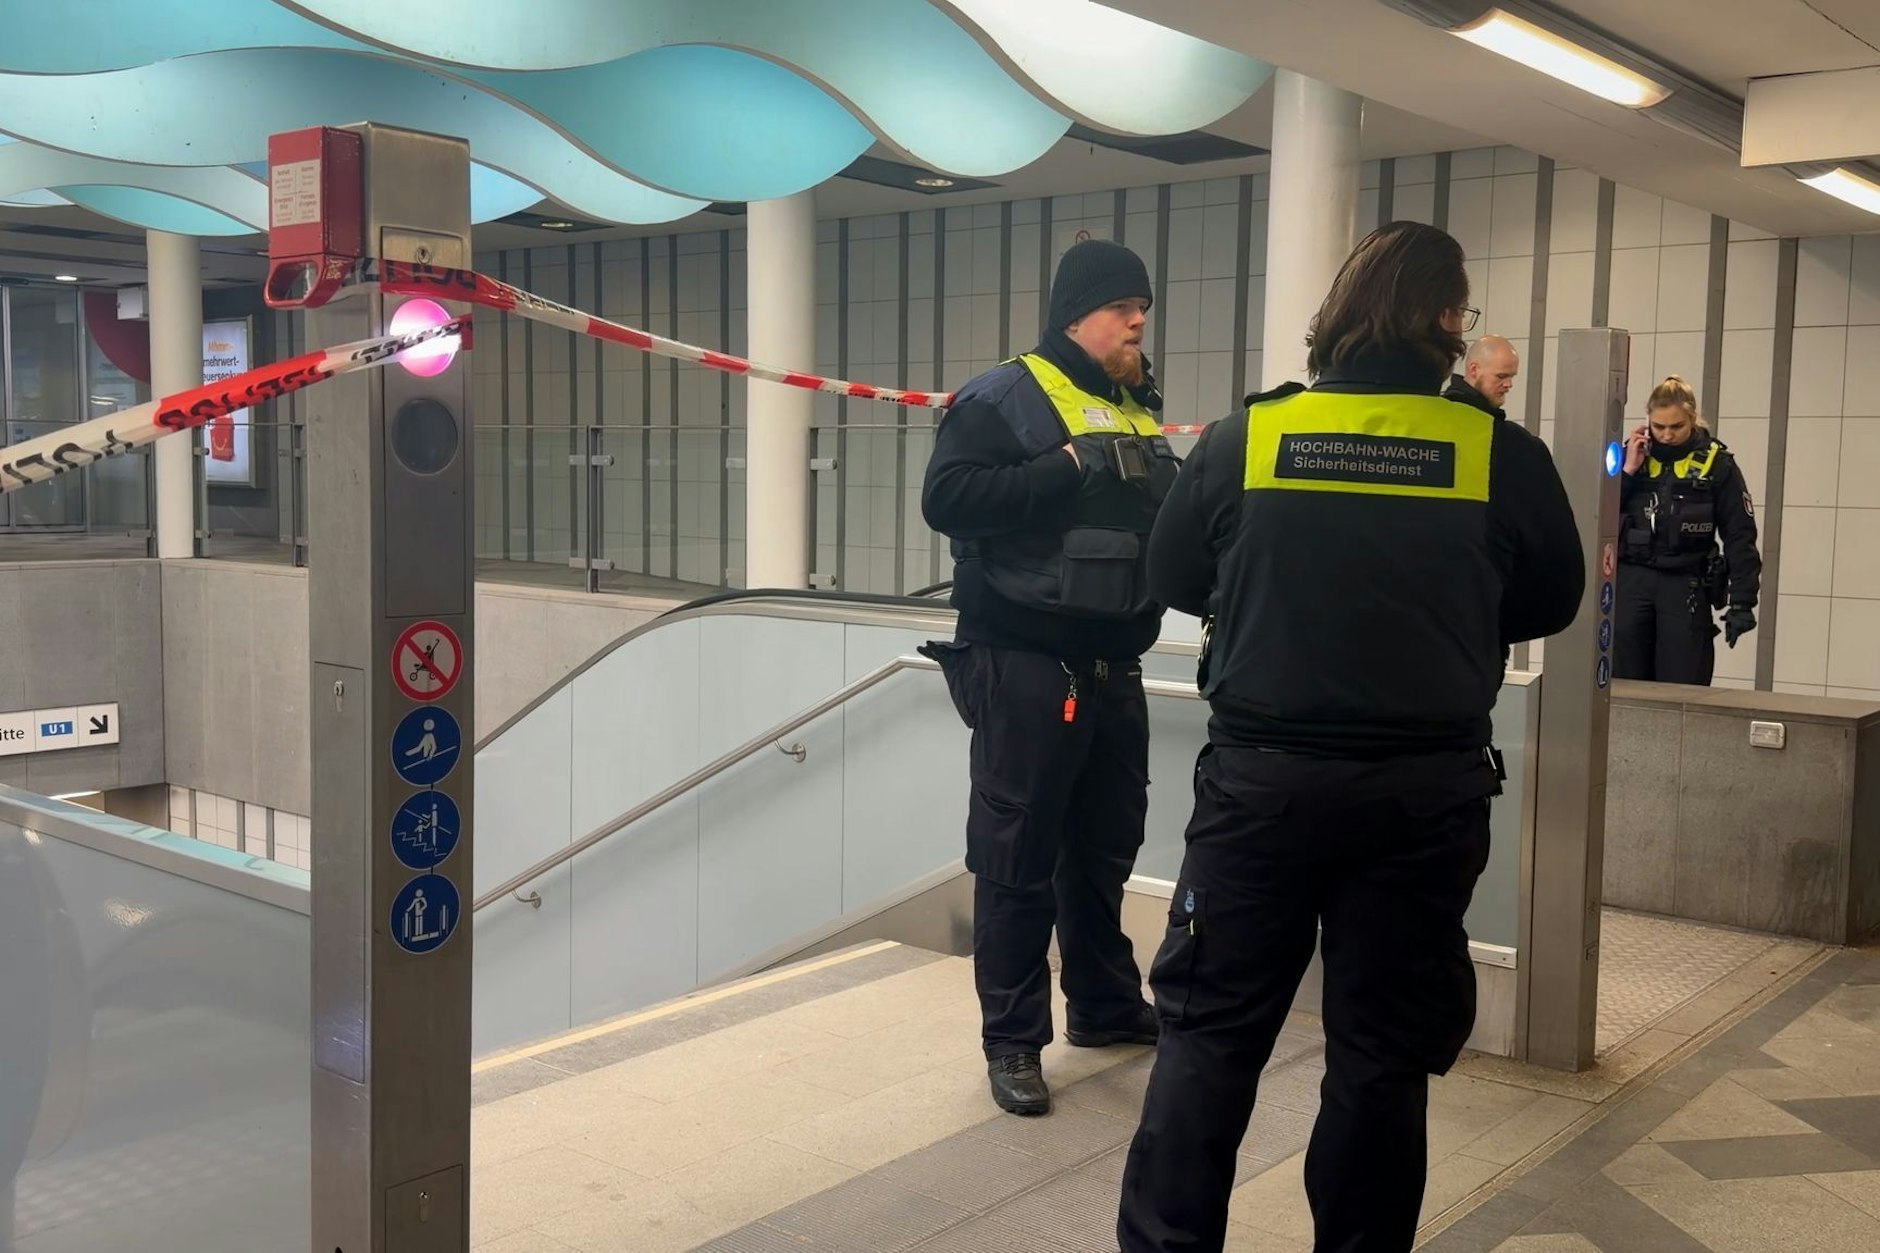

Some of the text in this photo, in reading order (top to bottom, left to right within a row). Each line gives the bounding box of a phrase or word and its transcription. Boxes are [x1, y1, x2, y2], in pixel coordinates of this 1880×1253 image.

[1289, 441, 1441, 462] HOCHBAHN-WACHE
[1293, 456, 1422, 476] Sicherheitsdienst
[1680, 522, 1713, 533] POLIZEI
[48, 723, 66, 735] U1
